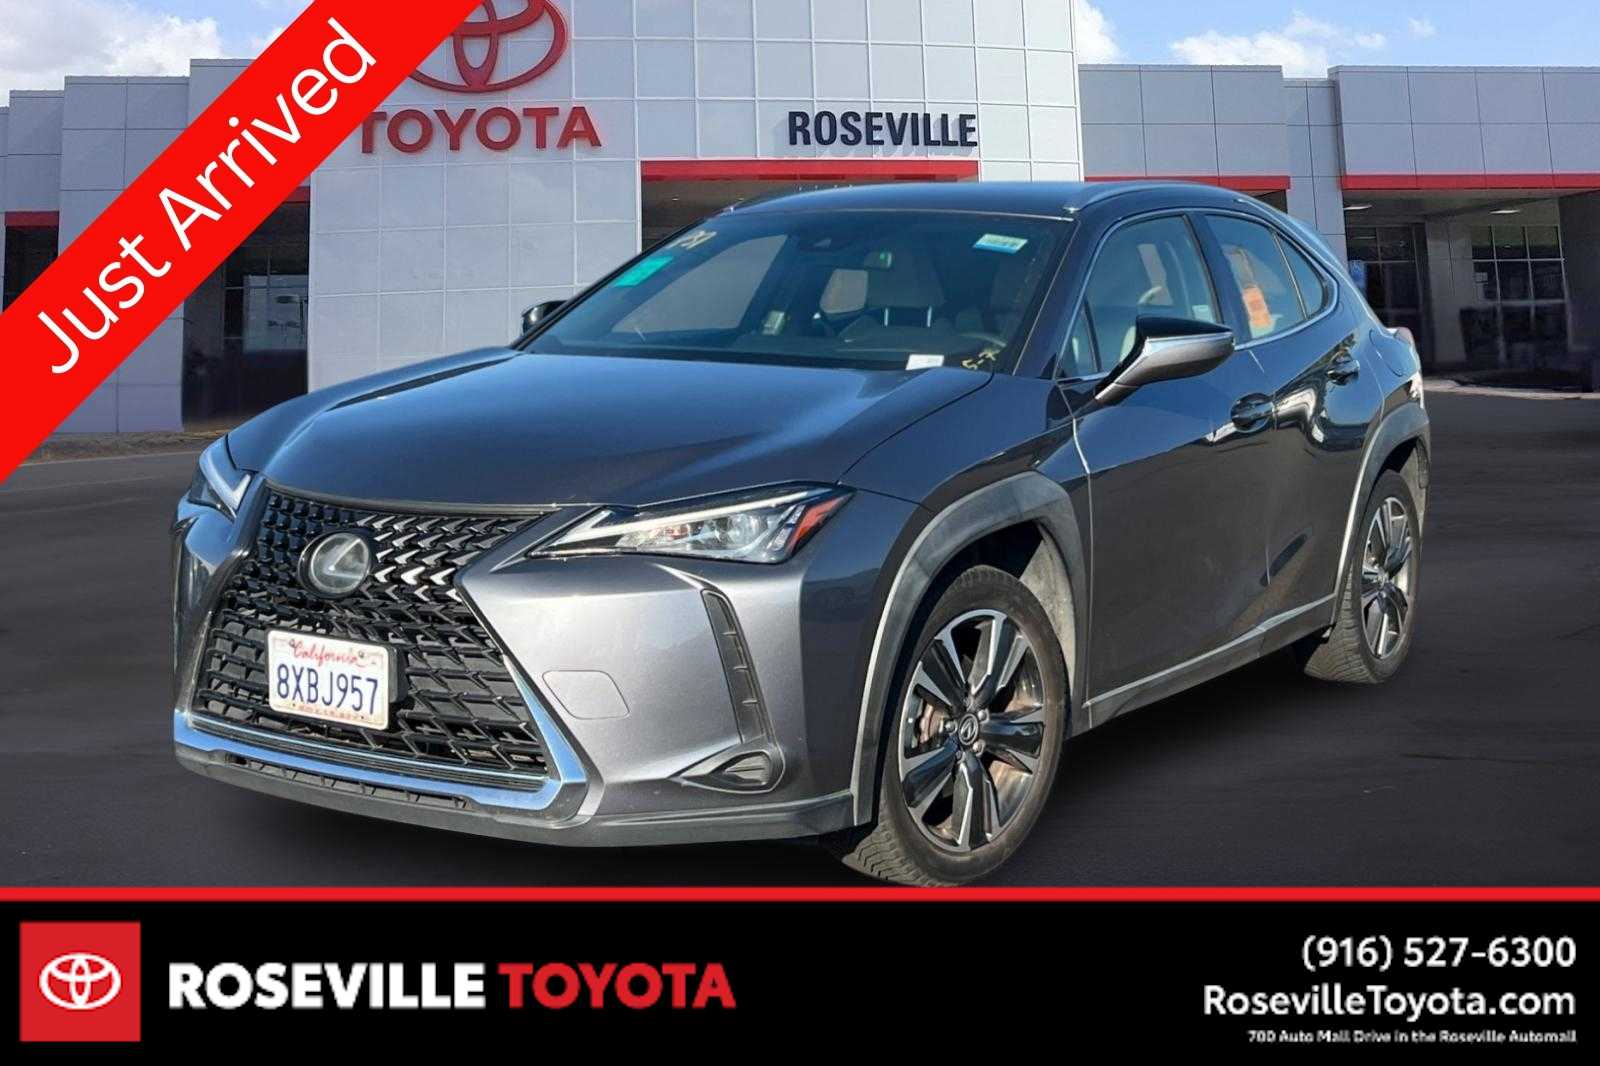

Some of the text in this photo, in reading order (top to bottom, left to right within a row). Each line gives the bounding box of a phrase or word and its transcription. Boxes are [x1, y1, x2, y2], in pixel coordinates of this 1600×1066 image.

[361, 106, 602, 154] TOYOTA
[788, 110, 978, 147] ROSEVILLE
[290, 641, 364, 668] California
[277, 663, 378, 715] 8XBJ957
